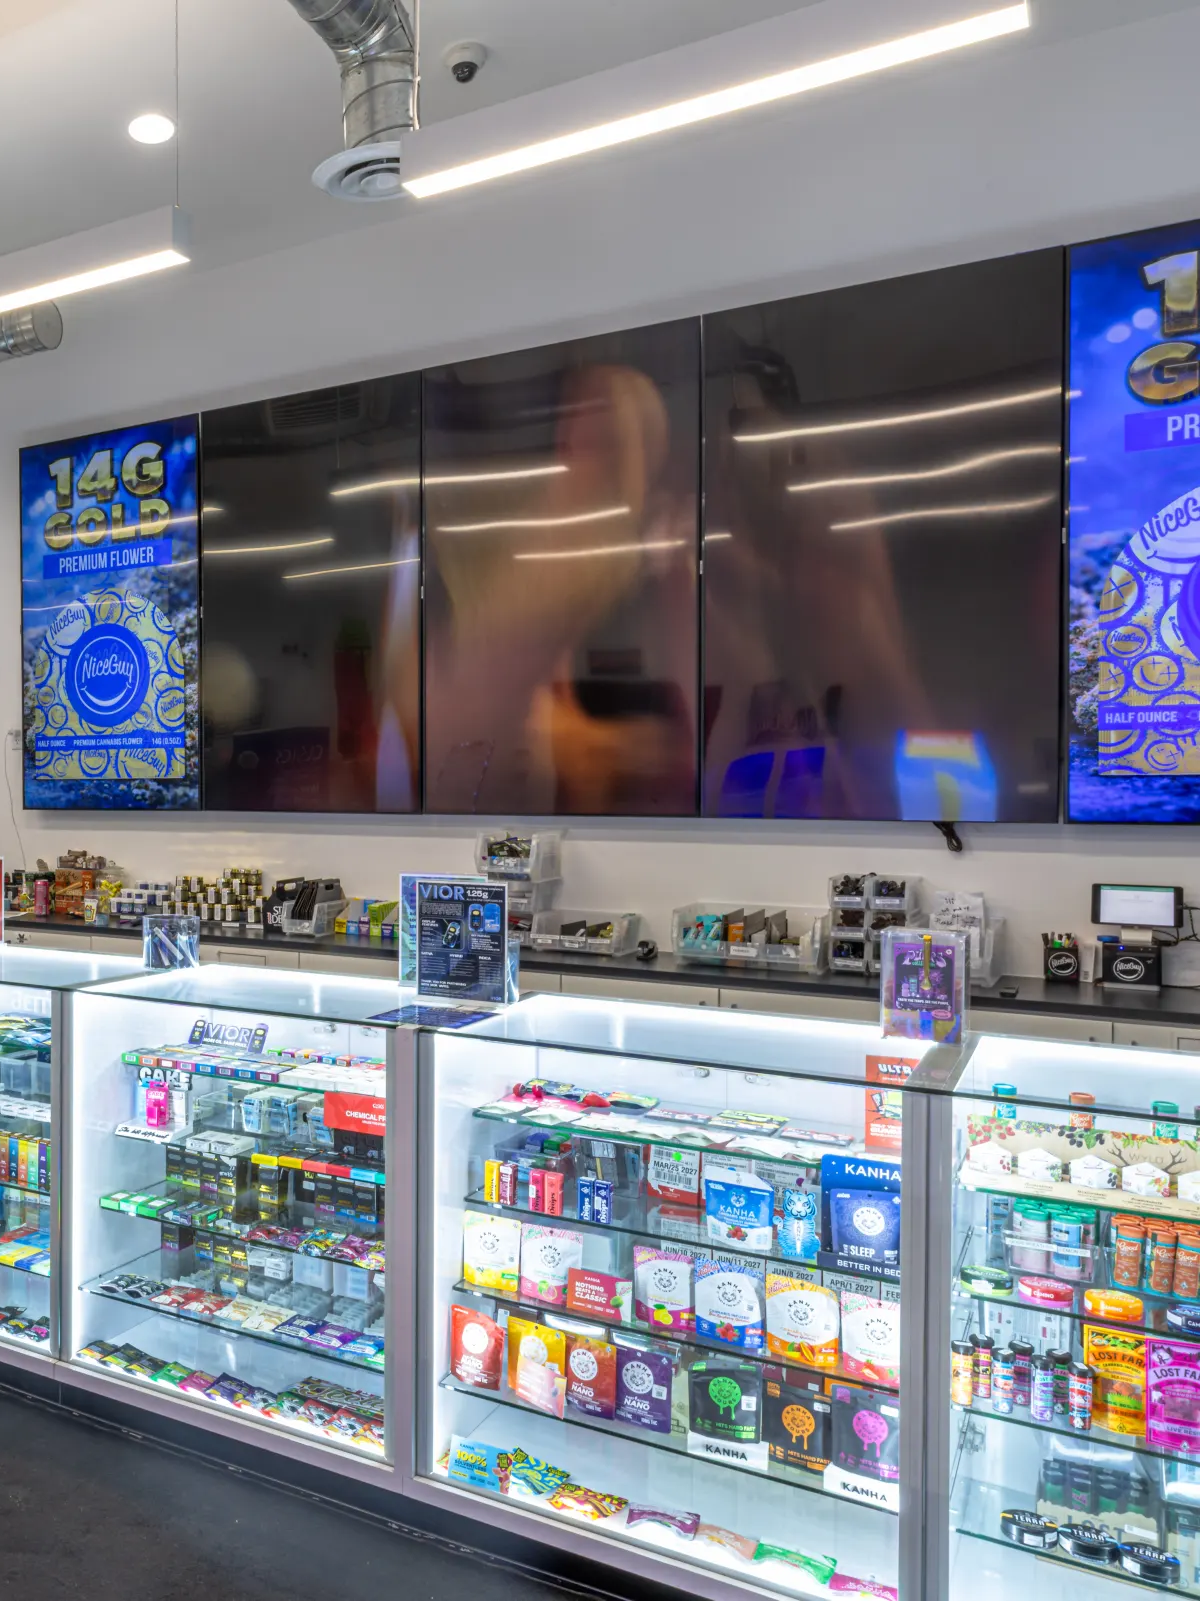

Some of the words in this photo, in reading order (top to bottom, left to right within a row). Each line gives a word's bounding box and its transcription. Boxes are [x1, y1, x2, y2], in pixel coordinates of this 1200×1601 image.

[48, 441, 165, 508] 14G
[44, 498, 171, 550] GOLD
[59, 552, 107, 574] PREMIUM
[110, 546, 154, 567] FLOWER
[49, 608, 86, 639] NiceGuy
[1110, 630, 1146, 647] NiceGuy
[81, 652, 134, 683] NiceGuy
[1105, 711, 1135, 724] HALF
[1137, 710, 1178, 723] OUNCE
[37, 740, 50, 748] HALF
[50, 739, 66, 747] OUNCE
[73, 739, 96, 747] PREMIUM
[96, 738, 122, 746] CANNABIS
[84, 881, 90, 891] 3
[420, 884, 465, 901] VIOR
[1051, 956, 1075, 969] NiceGuy
[1116, 961, 1142, 972] NiceGuy
[205, 1023, 253, 1043] VIOR
[139, 1067, 192, 1091] CAKE
[345, 1110, 378, 1121] CHEMICAL
[653, 1160, 680, 1172] MAR/25
[681, 1166, 698, 1176] 2027
[844, 1163, 902, 1182] KANHA
[580, 1197, 590, 1221] Drops
[597, 1199, 607, 1223] Drops
[719, 1204, 755, 1218] KANHA
[850, 1246, 875, 1258] SLEEP
[1116, 1241, 1139, 1252] Good
[689, 1250, 707, 1260] 2027
[716, 1255, 741, 1266] JUN/11
[743, 1260, 761, 1268] 2027
[837, 1259, 871, 1272] BETTER
[653, 1267, 677, 1281] KANHA
[795, 1271, 814, 1280] 2027
[575, 1281, 604, 1292] NOTHING
[716, 1280, 742, 1293] KANHA
[830, 1278, 853, 1290] APR/1
[855, 1284, 874, 1293] 2027
[575, 1291, 607, 1304] CLASSIC
[1032, 1290, 1055, 1300] CAMINO
[788, 1299, 814, 1312] KANHA
[572, 1351, 595, 1366] KANHA
[1091, 1352, 1118, 1361] LOST
[625, 1363, 651, 1378] KANHA
[1153, 1368, 1180, 1379] LOST
[571, 1384, 594, 1397] NANO
[624, 1398, 650, 1411] NANO
[786, 1407, 811, 1420] KANHA
[456, 1449, 487, 1467] 100%
[705, 1444, 748, 1461] KANHA
[787, 1449, 800, 1457] HITS
[840, 1482, 887, 1502] KANHA
[1014, 1513, 1045, 1526] TERRA
[1072, 1529, 1105, 1542] TERRA
[1133, 1547, 1166, 1561] TERRA
